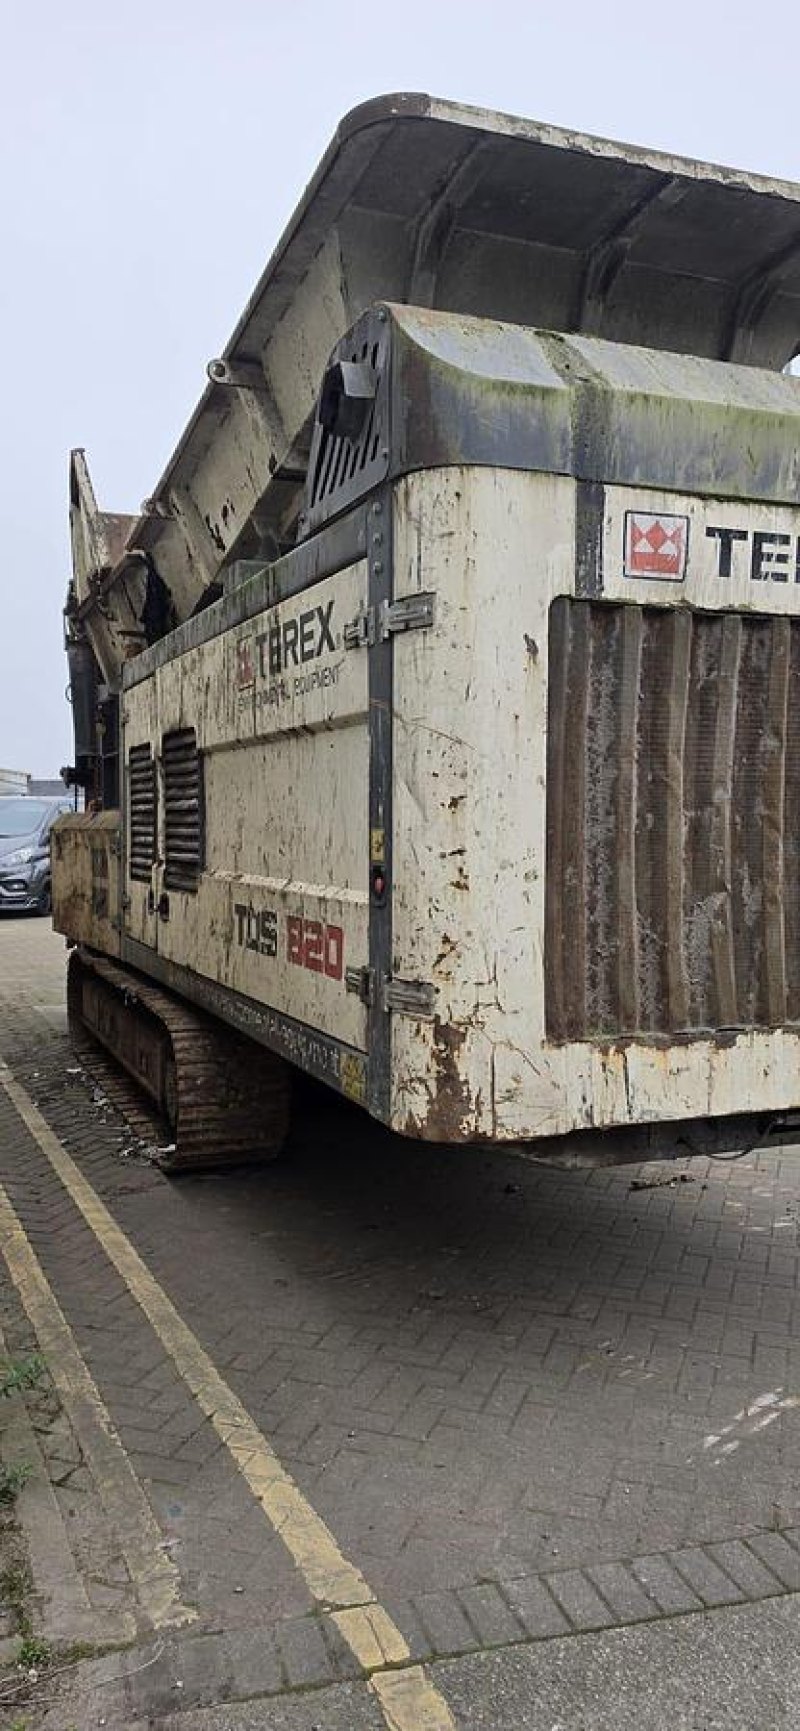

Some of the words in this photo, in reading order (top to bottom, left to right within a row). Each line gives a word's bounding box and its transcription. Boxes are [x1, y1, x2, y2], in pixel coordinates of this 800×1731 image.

[705, 526, 800, 584] TE
[256, 600, 335, 679] TEREX
[234, 904, 278, 957] TDS
[286, 915, 344, 980] 820
